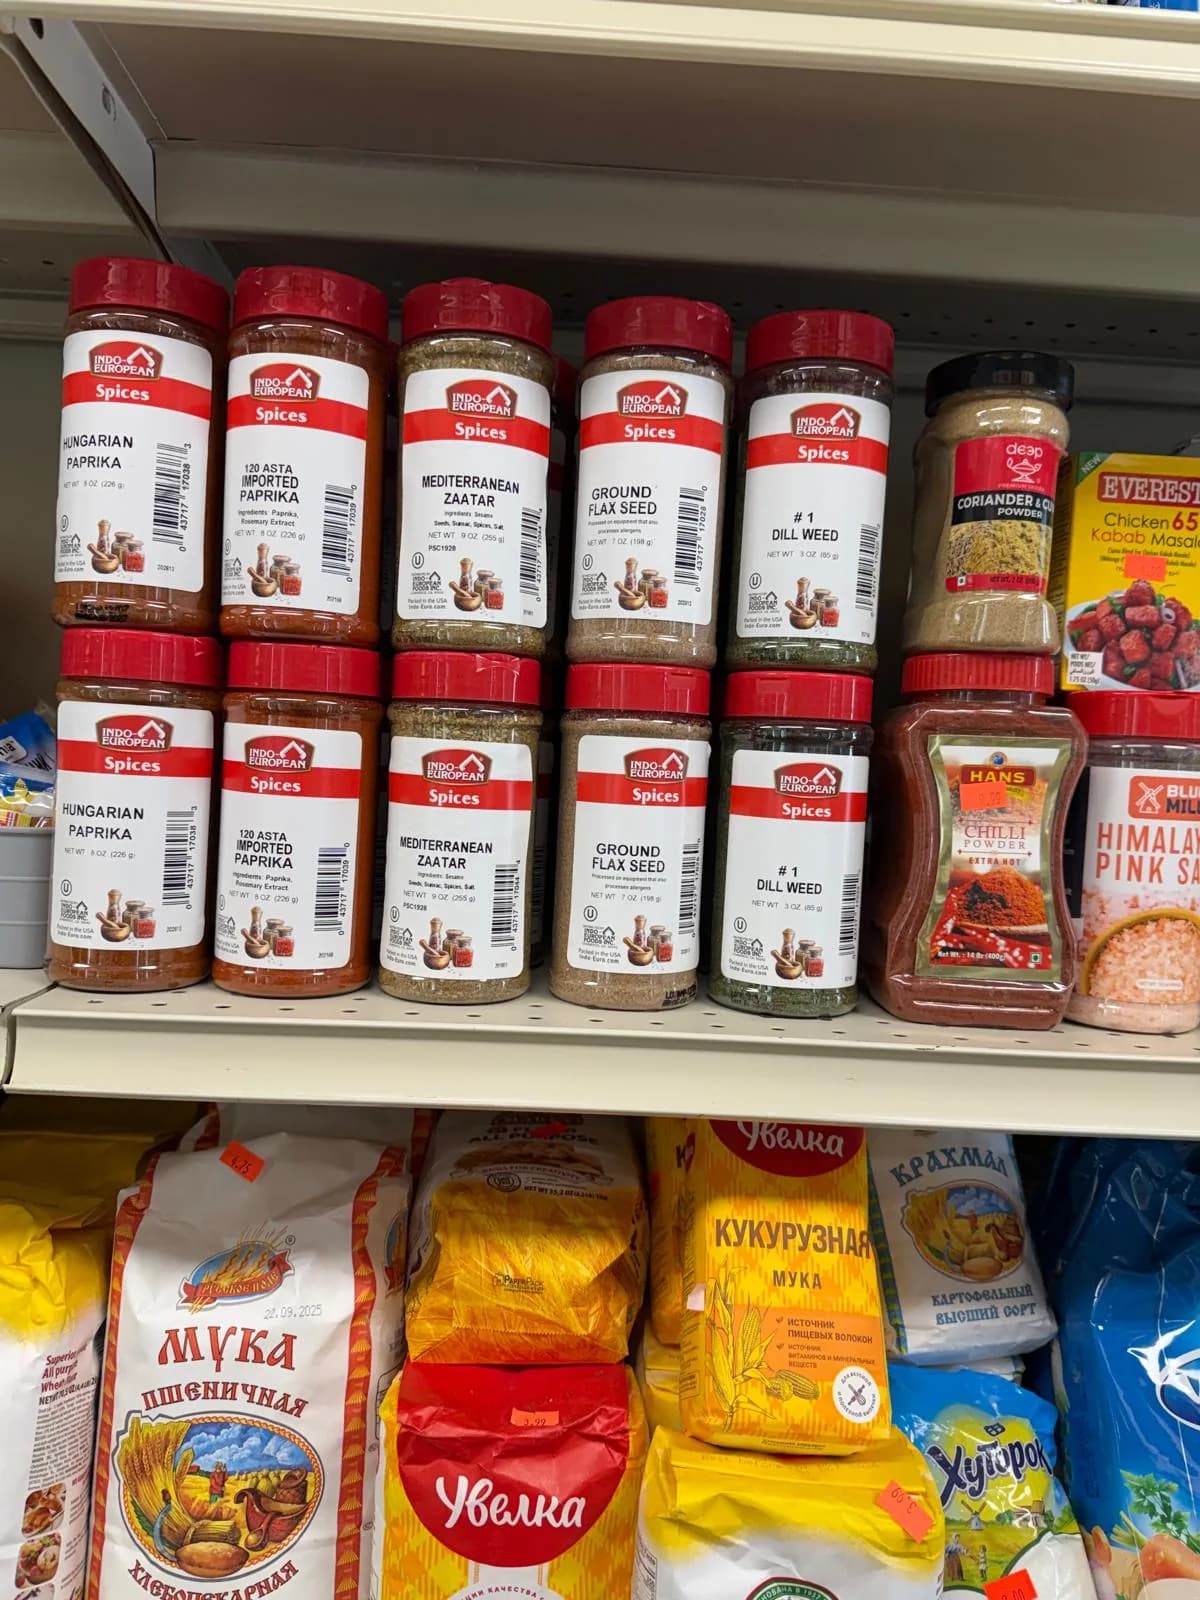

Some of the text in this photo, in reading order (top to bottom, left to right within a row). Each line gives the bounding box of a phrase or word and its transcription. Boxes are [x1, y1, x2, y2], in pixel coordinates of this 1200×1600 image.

[94, 364, 154, 377] EUROPEAN
[96, 384, 150, 401] Spices
[254, 387, 312, 399] EUROPEAN
[256, 407, 308, 424] Spices
[452, 402, 511, 416] EUROPEAN
[622, 403, 681, 416] EUROPEAN
[455, 422, 507, 440] Spices
[624, 424, 676, 441] Spices
[796, 426, 854, 437] EUROPEAN
[63, 434, 133, 450] HUNGARIAN
[798, 445, 849, 462] Spices
[1006, 443, 1043, 459] deep
[67, 456, 121, 469] PAPRIKA
[245, 463, 293, 474] 120 ASTA
[1081, 455, 1101, 474] NEW
[182, 463, 191, 490] 17038
[242, 475, 299, 489] IMPORTED
[422, 474, 519, 494] MEDITERRANEAN
[240, 490, 300, 504] PAPRIKA
[444, 493, 495, 507] ZAATAR
[592, 486, 652, 500] GROUND
[588, 501, 657, 517] FLAX SEED
[957, 494, 1033, 510] CORIANDER
[1035, 498, 1041, 508] &
[180, 503, 189, 530] 43717
[793, 512, 814, 523] # 1
[997, 508, 1043, 519] POWDER
[1104, 511, 1199, 532] Chicken 65
[772, 529, 839, 542] DILL WEED
[1091, 528, 1200, 549] Kabab Masal
[348, 538, 356, 564] 43717
[102, 737, 166, 749] EUROPEAN
[104, 756, 161, 773] Spices
[249, 758, 306, 769] EUROPEAN
[427, 770, 485, 782] EUROPEAN
[630, 769, 684, 779] EUROPEAN
[970, 771, 1025, 783] HANS
[251, 776, 301, 793] Spices
[780, 783, 836, 795] EUROPEAN
[429, 789, 480, 806] Spices
[632, 788, 679, 804] Spices
[62, 803, 144, 820] HUNGARIAN
[782, 803, 832, 819] Spices
[69, 825, 132, 840] PAPRIKA
[189, 825, 197, 851] 17038
[240, 829, 287, 842] 120 ASTA
[964, 825, 1025, 840] CHILLI
[236, 839, 293, 855] IMPORTED
[400, 836, 493, 854] MEDITERRANEAN
[596, 843, 661, 857] GROUND
[964, 840, 1026, 849] POWDER
[234, 853, 293, 869] PAPRIKA
[418, 855, 466, 870] ZAATAR
[592, 857, 665, 873] FLAX SEED
[968, 857, 1021, 866] EXTRA HOT
[1096, 852, 1164, 884] PINK
[342, 860, 350, 883] 17039
[778, 866, 798, 877] # 1
[757, 879, 822, 894] DILL WEED
[339, 894, 347, 917] 43717
[468, 1133, 503, 1144] ALL
[737, 1121, 844, 1158] Увелка
[715, 1219, 872, 1259] КУКУРУЗНАЯ
[773, 1270, 822, 1289] МУКА
[932, 1284, 1033, 1306] КАРТОФЕЛЬНЫЙ
[936, 1303, 1037, 1325] ВЫСШИЙ СОРТ
[788, 1318, 835, 1329] ИСТОЧНИК
[788, 1330, 873, 1344] ПИЩЕВЫХ ВОЛОКОН
[158, 1325, 297, 1372] МУКА
[42, 1367, 54, 1379] All
[141, 1381, 309, 1418] ПШЕНИЧНАЯ
[435, 1475, 586, 1529] Увелка
[487, 1586, 537, 1598] КАЧЕСТВА
